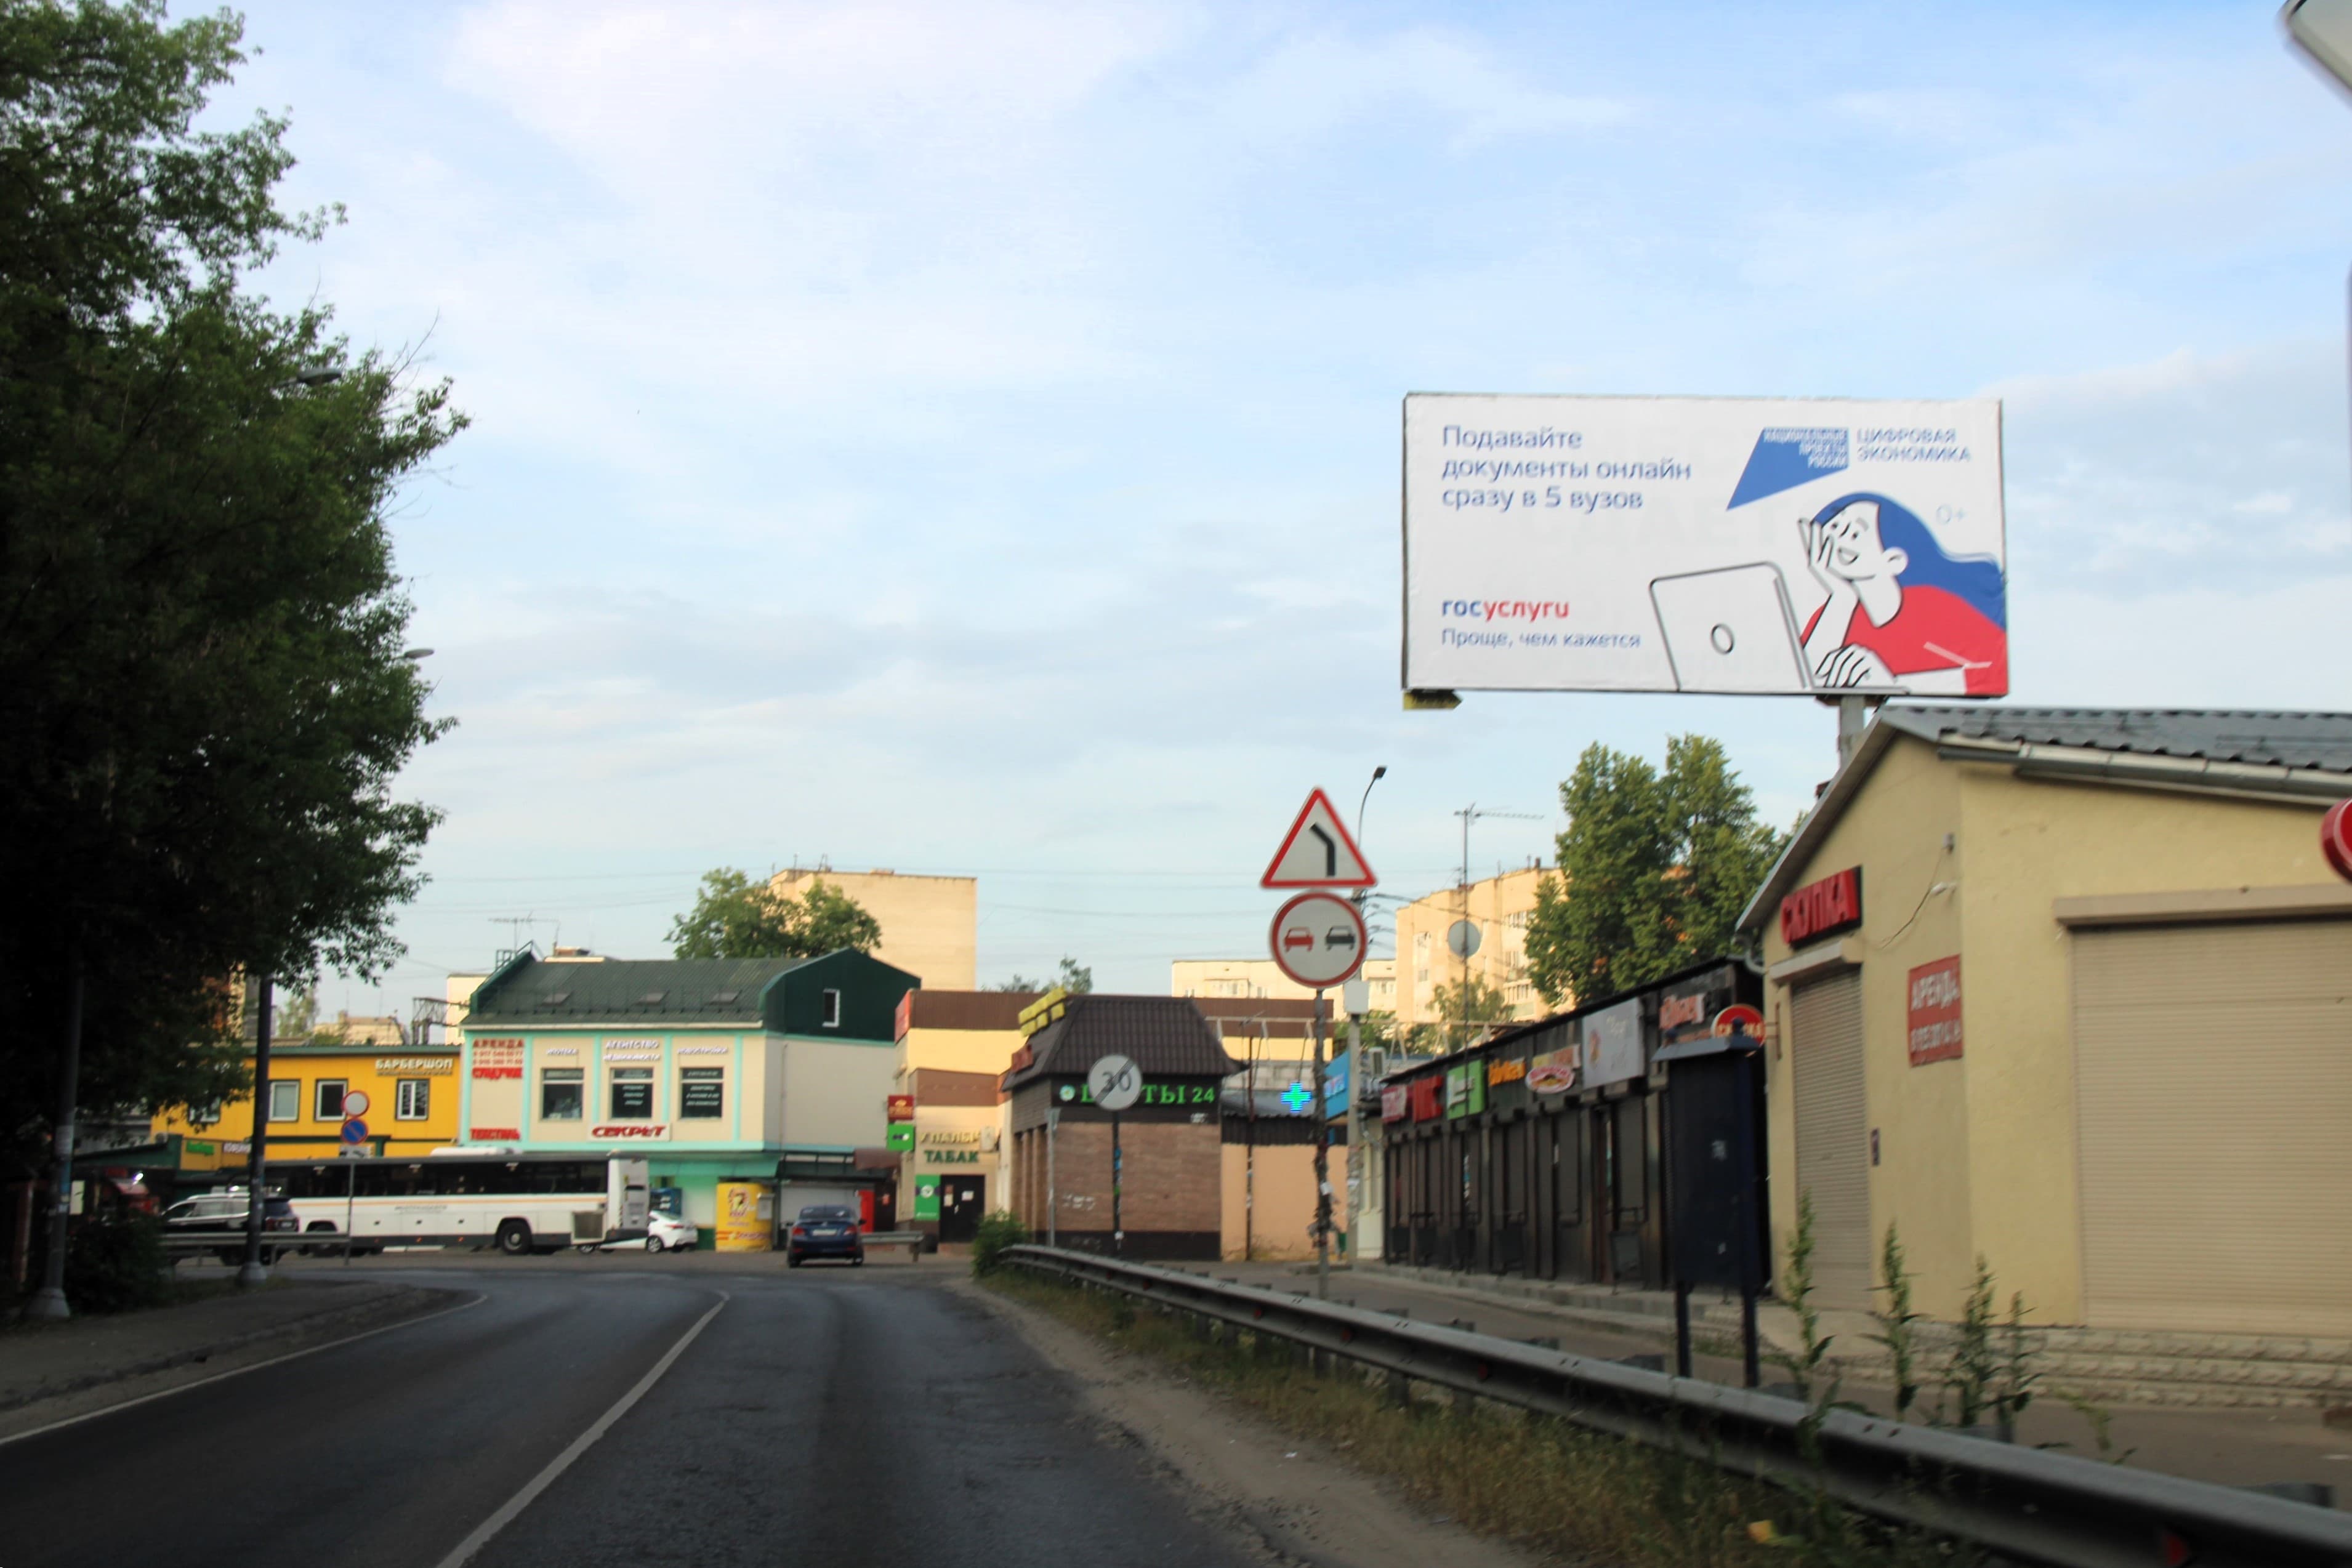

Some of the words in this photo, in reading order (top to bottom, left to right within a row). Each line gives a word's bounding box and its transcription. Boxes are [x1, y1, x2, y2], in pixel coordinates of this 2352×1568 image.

[1442, 425, 1582, 451] Подавайте
[1857, 428, 1957, 444] ЦИФРОВАЯ
[1857, 446, 1971, 463] ЭКОНОМИКА
[1442, 458, 1589, 482] документы
[1596, 457, 1692, 480] онлайн
[1442, 489, 1515, 512] сразу
[1522, 491, 1537, 509] в
[1545, 485, 1562, 509] 5
[1569, 491, 1644, 514] вузов
[1441, 600, 1569, 622] госуслуги
[1441, 627, 1514, 648] Проще,
[1518, 633, 1558, 647] чем
[1563, 633, 1642, 648] кажется
[1781, 868, 1859, 944] СКУПКА
[472, 1039, 524, 1049] АРЕНДА
[376, 1058, 454, 1069] БАРБЕРШОП
[1101, 1071, 1132, 1093] 30
[1191, 1086, 1215, 1104] 24
[592, 1125, 667, 1138] СЕКРЕТ
[924, 1150, 979, 1164] ТАБАК
